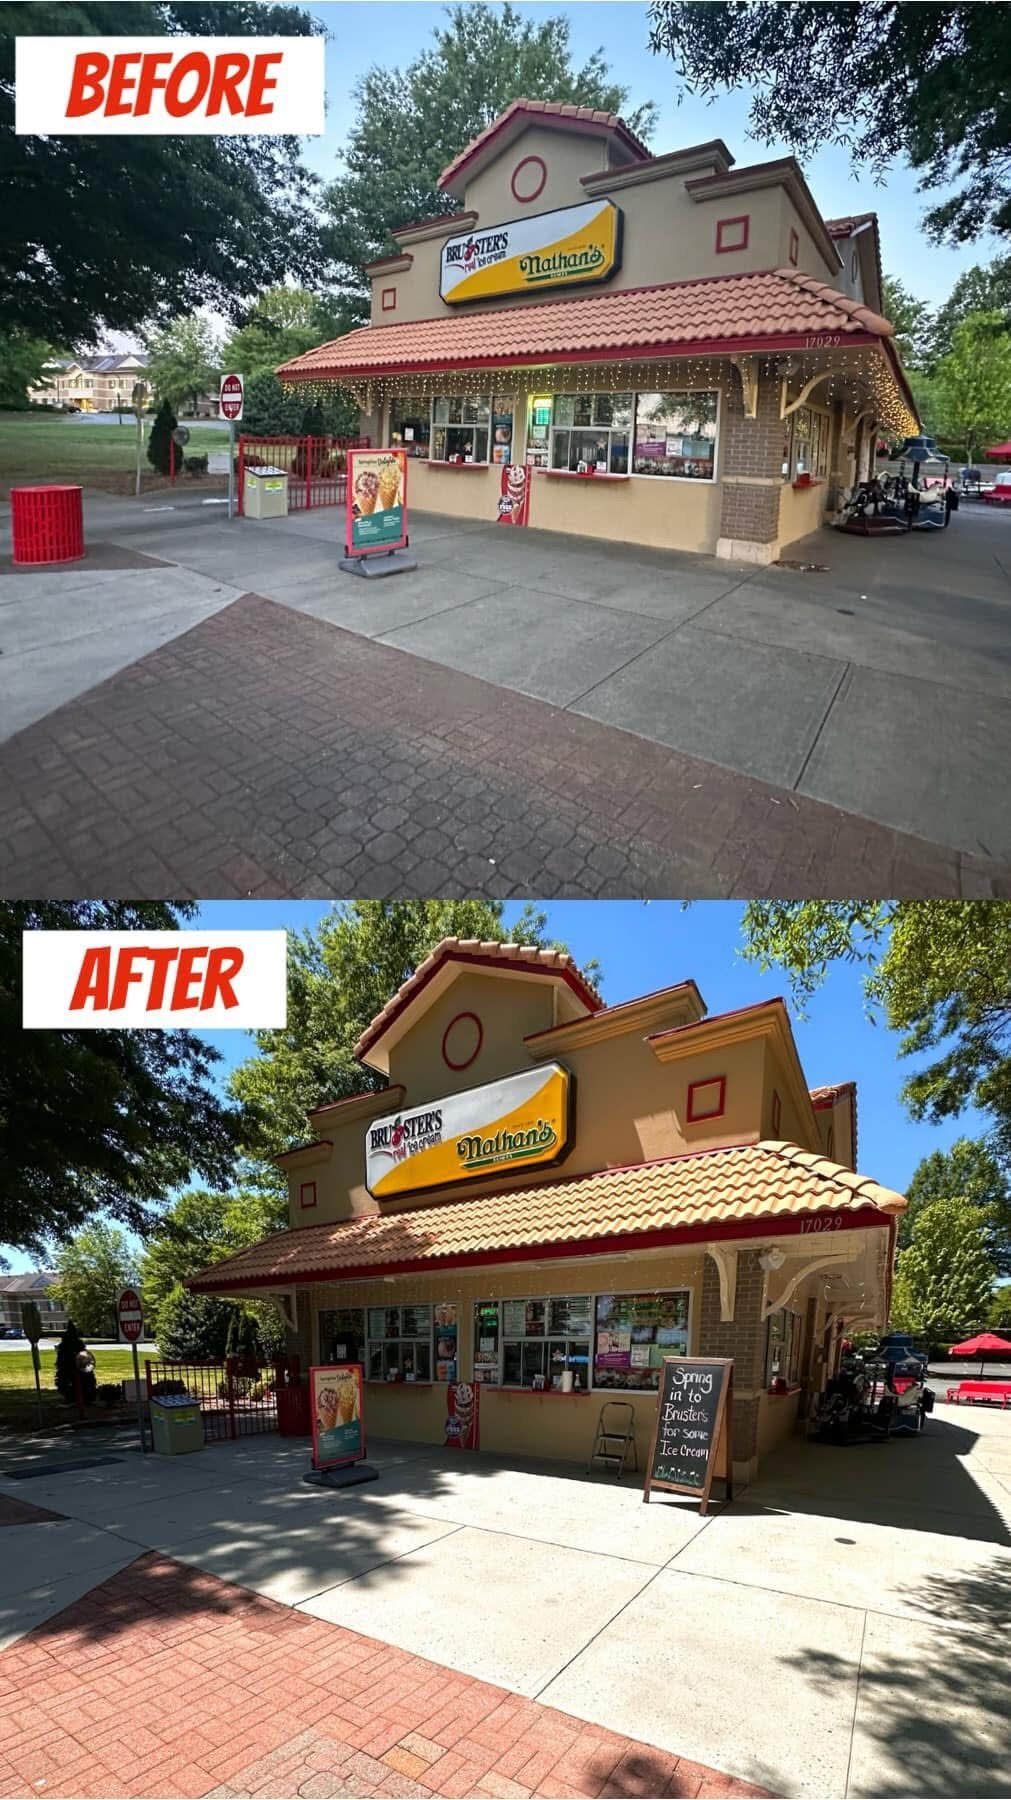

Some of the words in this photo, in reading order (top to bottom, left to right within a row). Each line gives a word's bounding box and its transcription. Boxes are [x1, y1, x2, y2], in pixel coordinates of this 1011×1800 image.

[446, 232, 508, 263] BRUSTER'S
[520, 244, 604, 275] Nathan's
[806, 335, 841, 349] 17029
[224, 384, 231, 392] DO
[232, 383, 240, 391] NOT
[224, 403, 240, 411] ENTER
[370, 1109, 443, 1150] BRUSTER'S
[457, 1119, 557, 1160] Nathan's
[801, 1216, 842, 1232] 17029
[124, 1322, 140, 1332] ENTER
[672, 1367, 713, 1394] Spring
[670, 1387, 682, 1401] in
[688, 1389, 702, 1403] to
[662, 1422, 680, 1438] for
[682, 1428, 709, 1440] some
[660, 1440, 678, 1456] Ice
[680, 1444, 709, 1461] Cream
